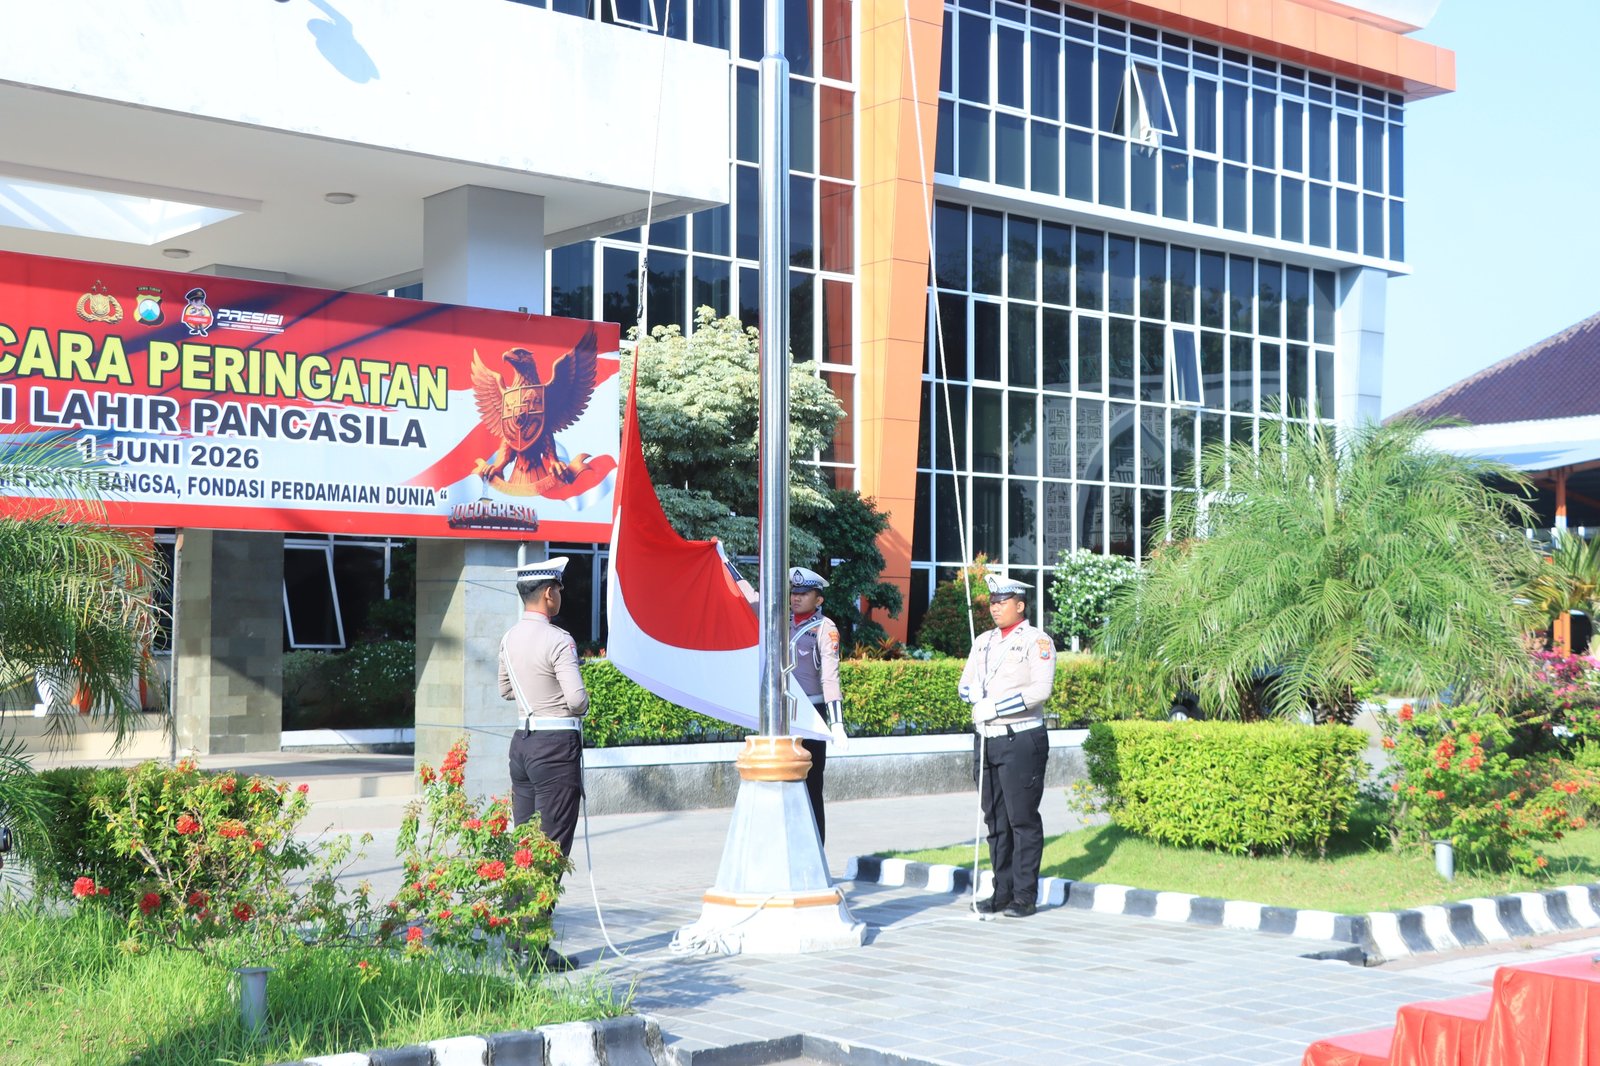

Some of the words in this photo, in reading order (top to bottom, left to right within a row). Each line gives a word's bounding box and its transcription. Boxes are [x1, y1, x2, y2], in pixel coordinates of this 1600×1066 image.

[216, 308, 284, 326] PRESISI
[147, 339, 448, 411] PERINGATAN
[34, 390, 178, 432] LAHIR
[194, 403, 427, 448] PANCASILA
[80, 437, 93, 461] 1
[107, 441, 180, 465] JUNI
[191, 445, 259, 469] 2026
[98, 472, 181, 498] BANGSA,
[188, 476, 265, 499] FONDASI
[271, 480, 380, 504] PERDAMAIAN
[386, 486, 436, 506] DUNIA
